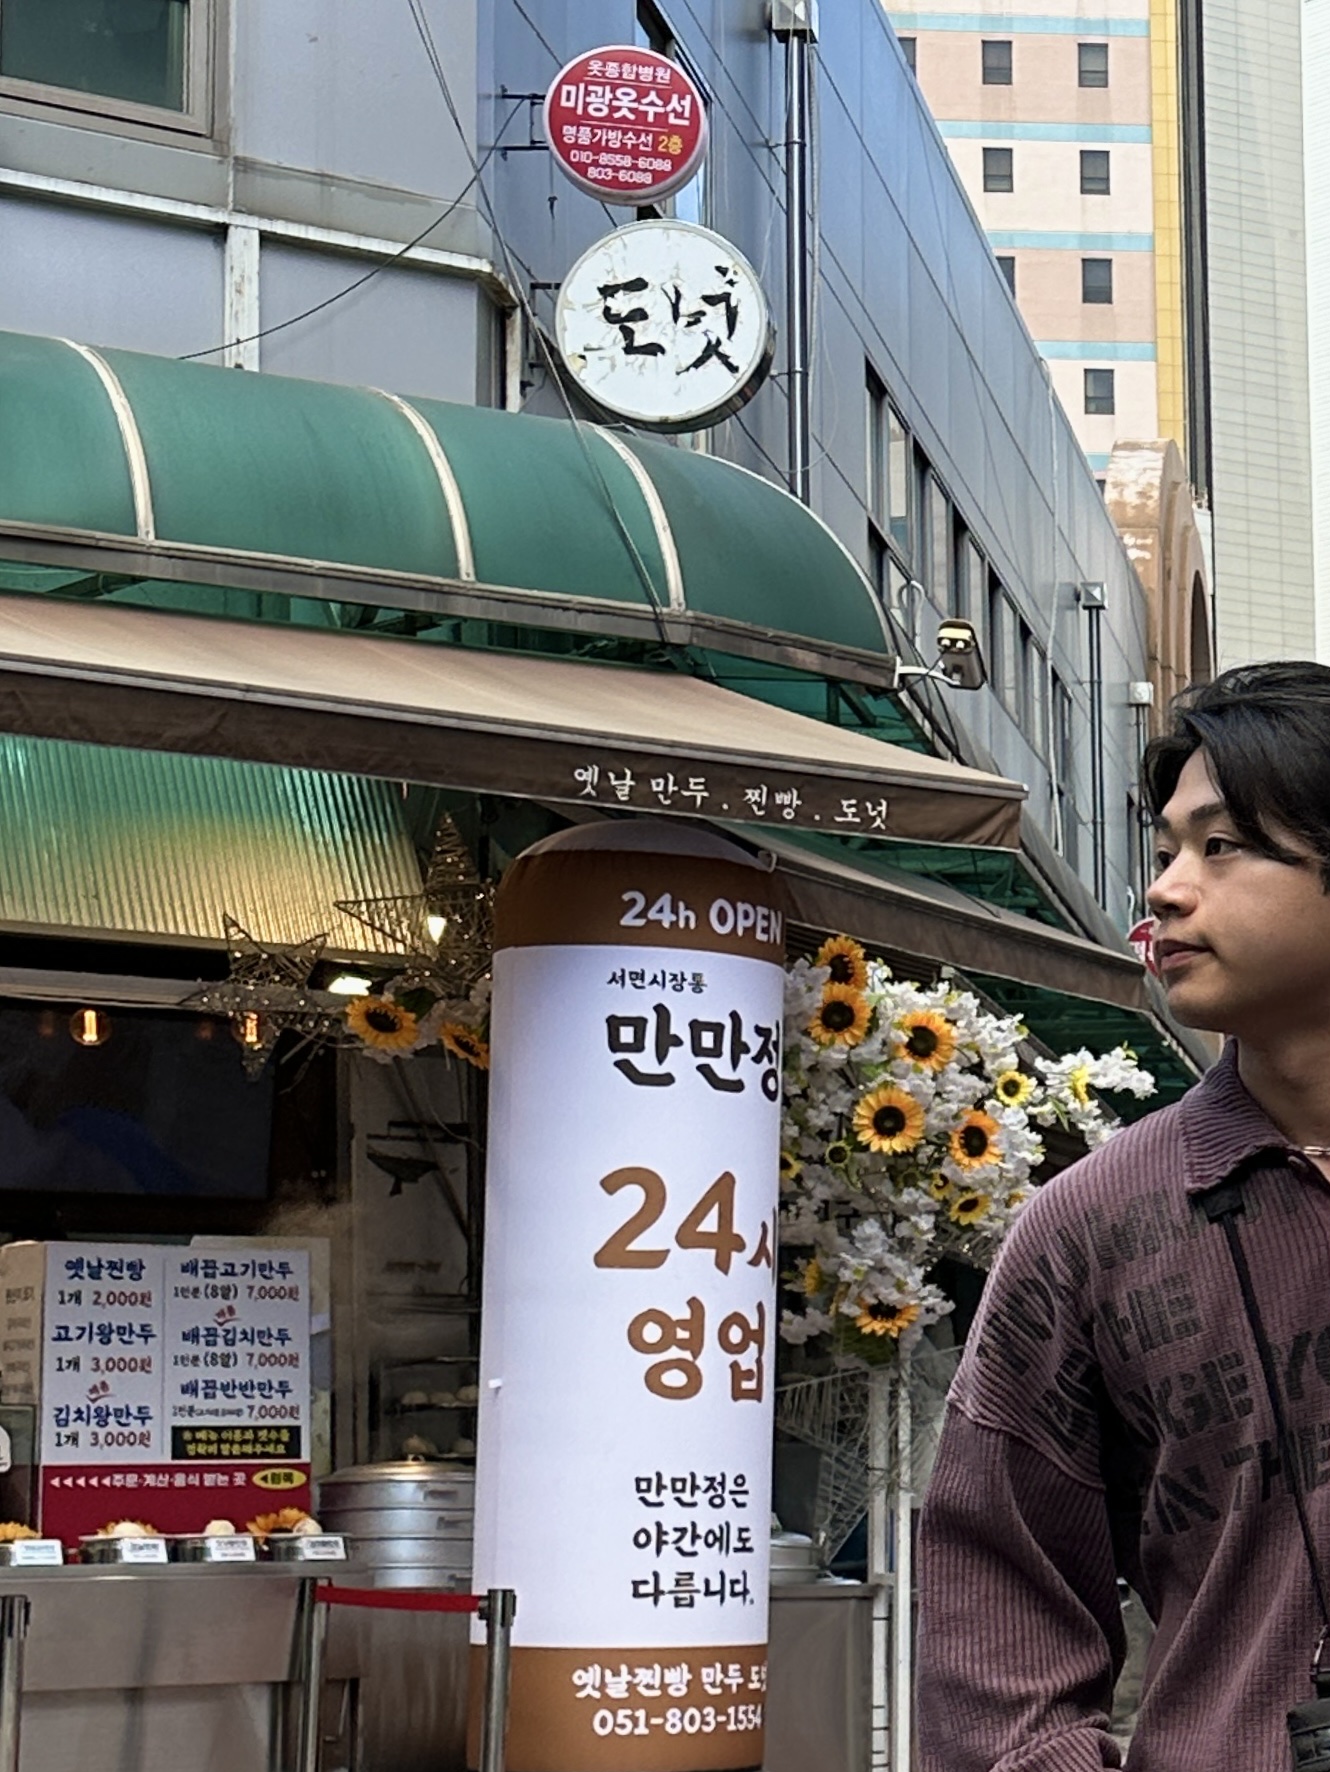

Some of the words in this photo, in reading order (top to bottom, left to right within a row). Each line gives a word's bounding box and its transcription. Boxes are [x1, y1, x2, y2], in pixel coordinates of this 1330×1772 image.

[587, 60, 671, 84] 옷종합병원
[560, 83, 692, 126] 미광옷수선
[562, 125, 653, 151] 명품가방수선
[658, 134, 683, 155] 2층
[574, 764, 635, 801] 옛날
[650, 773, 710, 809] 만두
[743, 785, 802, 822] 찐빵
[833, 799, 889, 830] 도넛
[618, 889, 697, 931] 24h
[708, 897, 783, 945] OPEN
[606, 967, 708, 994] 서면시장통
[605, 1002, 782, 1103] 만만정
[64, 1256, 147, 1281] 옛날찐빵
[58, 1289, 82, 1306] 1개
[92, 1289, 153, 1309] 2,000원
[246, 1284, 300, 1302] 7,000원
[51, 1321, 157, 1345] 고기왕만두
[246, 1352, 300, 1370] 7,000원
[627, 1296, 767, 1403] 영업
[56, 1356, 81, 1373] 1개
[91, 1355, 153, 1374] 3,000원
[53, 1404, 153, 1428] 김치왕만두
[246, 1404, 300, 1420] 7,000원
[55, 1430, 79, 1448] 1개
[90, 1430, 151, 1449] 3,000원
[634, 1471, 751, 1510] 만만정은
[632, 1521, 756, 1558] 야간에도
[631, 1569, 755, 1609] 다릅니다.
[571, 1662, 693, 1699] 옛날찐빵
[701, 1661, 745, 1695] 만두
[592, 1705, 763, 1737] 051-803-1554
